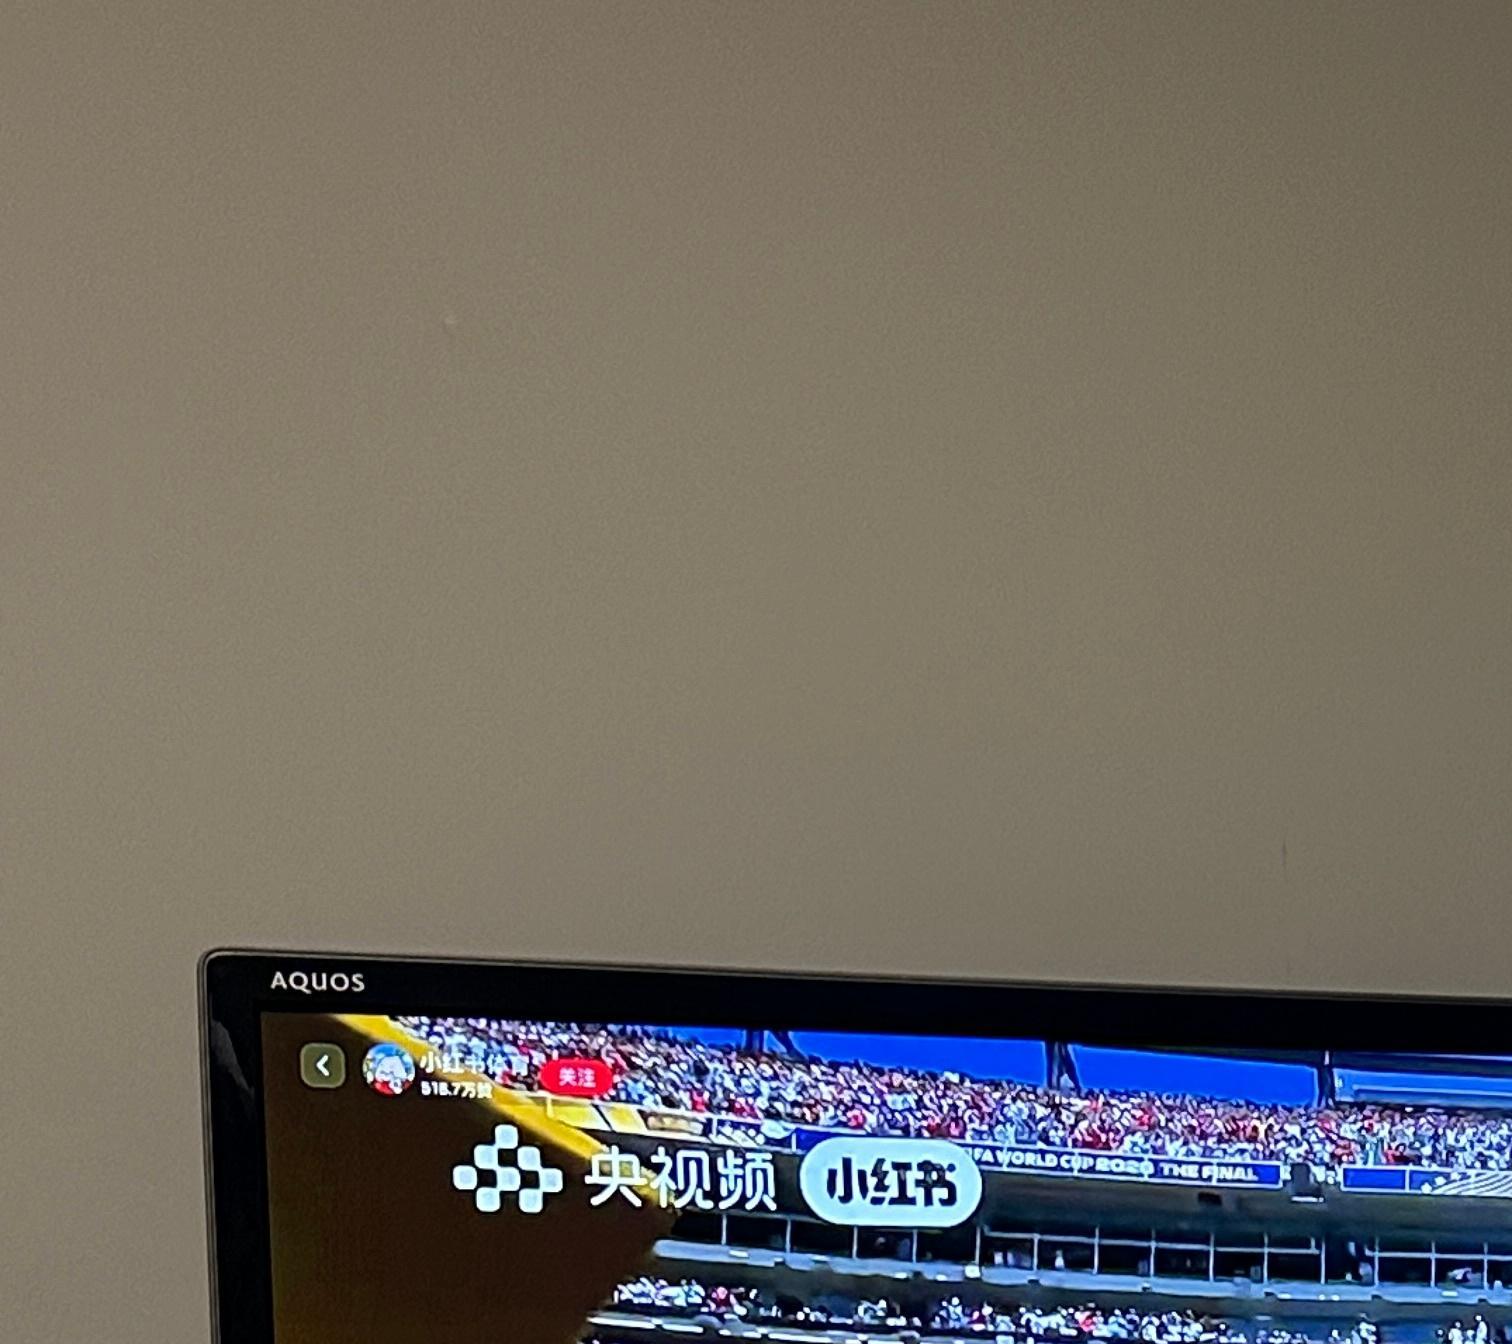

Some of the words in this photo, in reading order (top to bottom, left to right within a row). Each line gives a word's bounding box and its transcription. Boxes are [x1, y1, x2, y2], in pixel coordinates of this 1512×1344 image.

[270, 971, 366, 993] AQUOS
[559, 1066, 597, 1089] 关注
[584, 1145, 778, 1211] 央视频
[825, 1156, 958, 1207] 小红书
[995, 1149, 1059, 1168] WORLD
[1159, 1162, 1199, 1179] THE
[1201, 1165, 1259, 1182] FINAL
